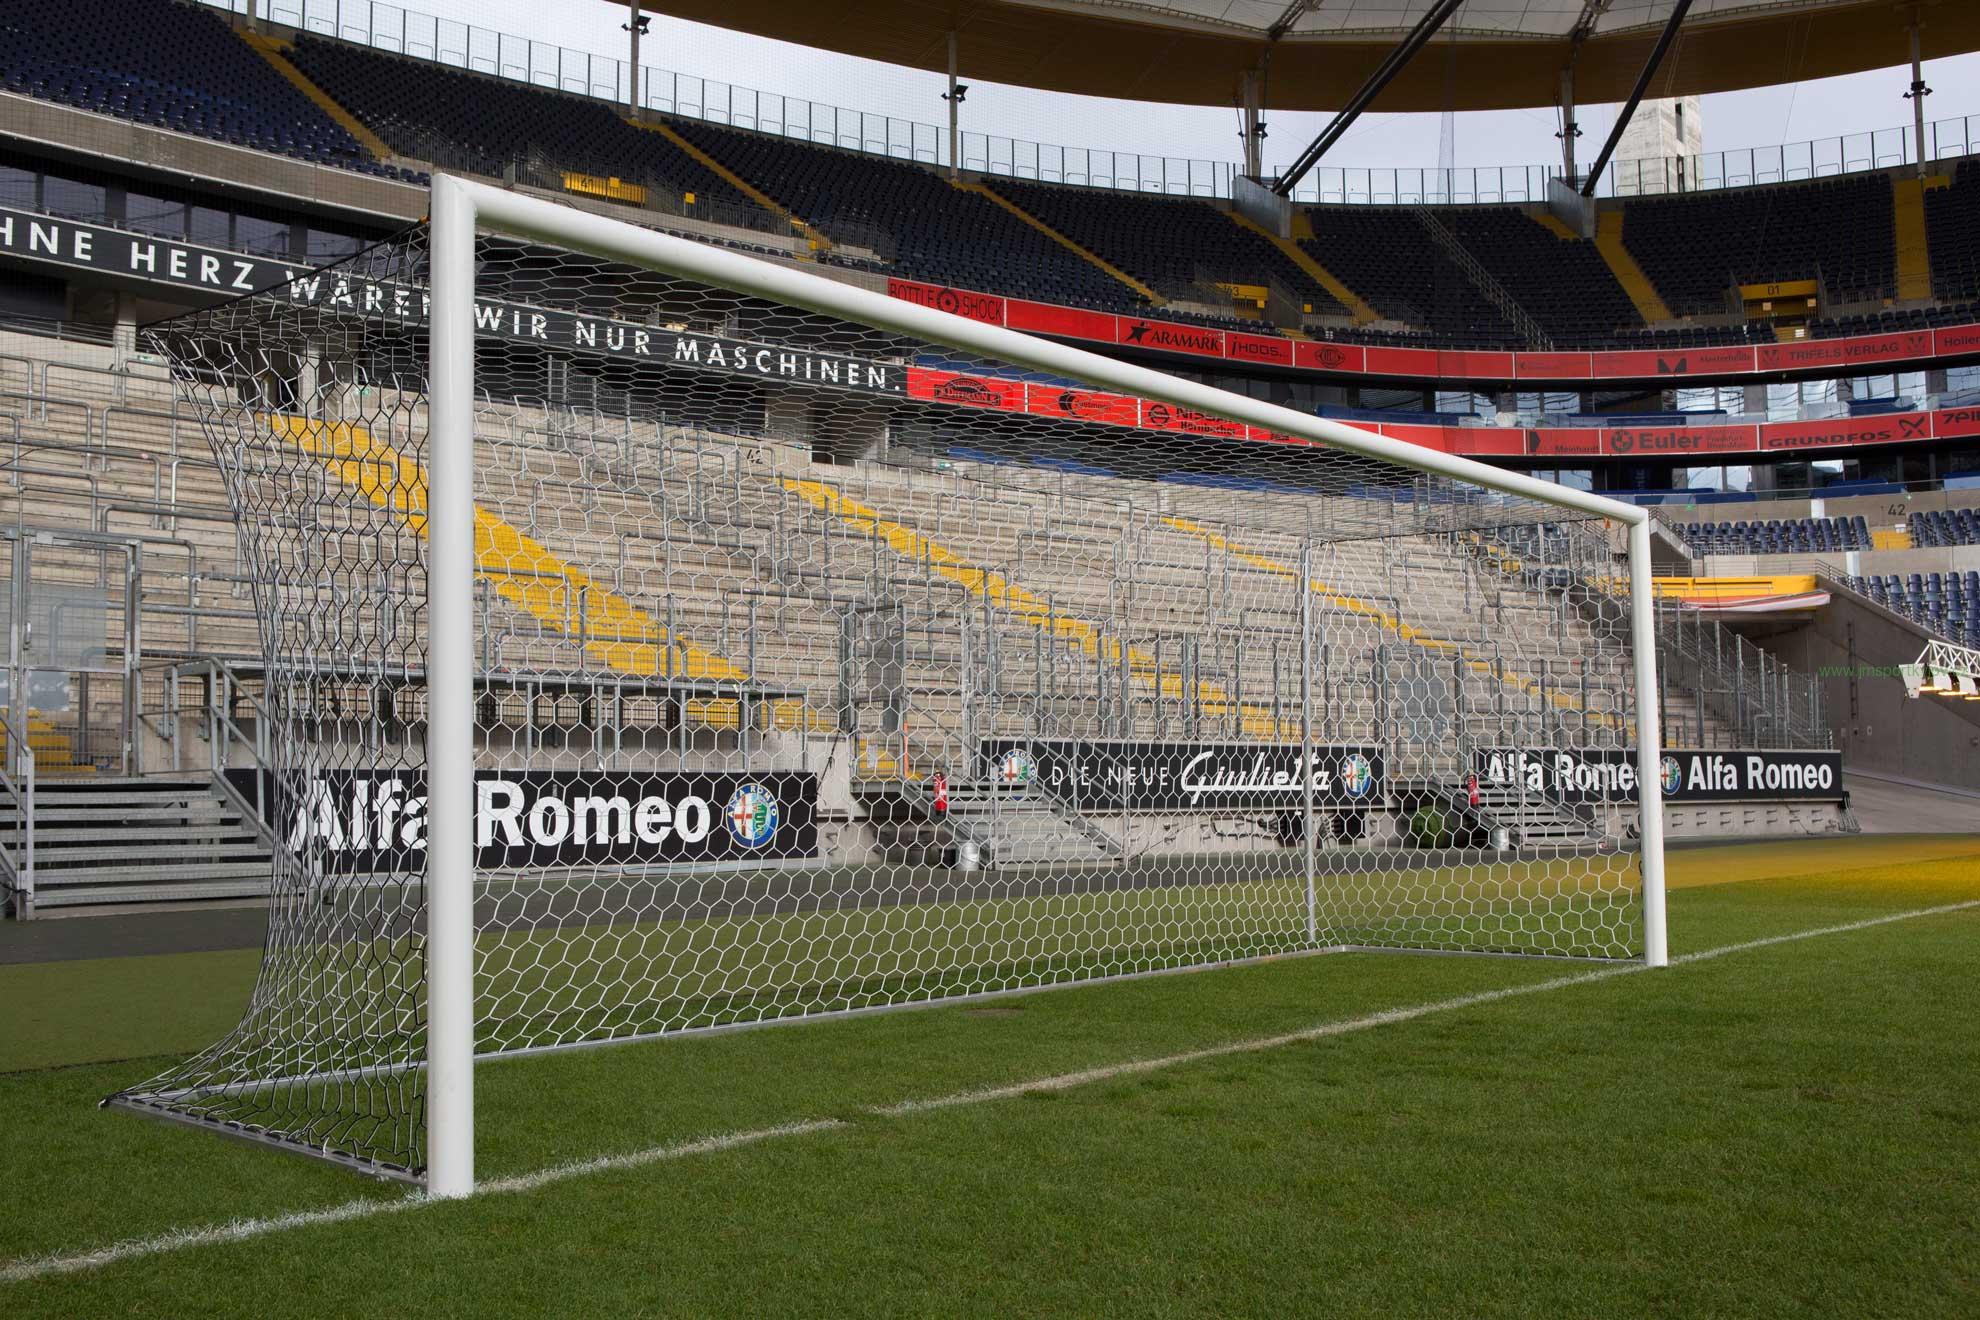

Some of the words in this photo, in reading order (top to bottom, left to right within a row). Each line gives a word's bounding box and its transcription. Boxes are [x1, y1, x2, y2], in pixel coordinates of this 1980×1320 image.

[131, 241, 254, 290] HERZ
[285, 270, 430, 316] WARE
[474, 304, 547, 340] WIR
[575, 321, 651, 355] NUR
[889, 283, 934, 308] BOTTLE
[963, 296, 1003, 321] SHOCK
[1151, 329, 1219, 352] ARAMARK
[1789, 346, 1841, 361] TRIFELS
[1846, 342, 1899, 357] VERLAG
[1639, 432, 1702, 449] Euler
[1769, 430, 1892, 447] GRUNDFOS
[747, 449, 763, 465] 42
[1887, 503, 1906, 516] 42
[1052, 766, 1090, 787] DIE
[1108, 766, 1169, 787] NEUE
[1488, 753, 1544, 792] Alfa
[1554, 754, 1639, 791] Rome
[1687, 755, 1738, 791] Alfa
[1747, 756, 1833, 791] Romeo
[287, 779, 428, 850] Alfa
[477, 779, 710, 848] Romeo
